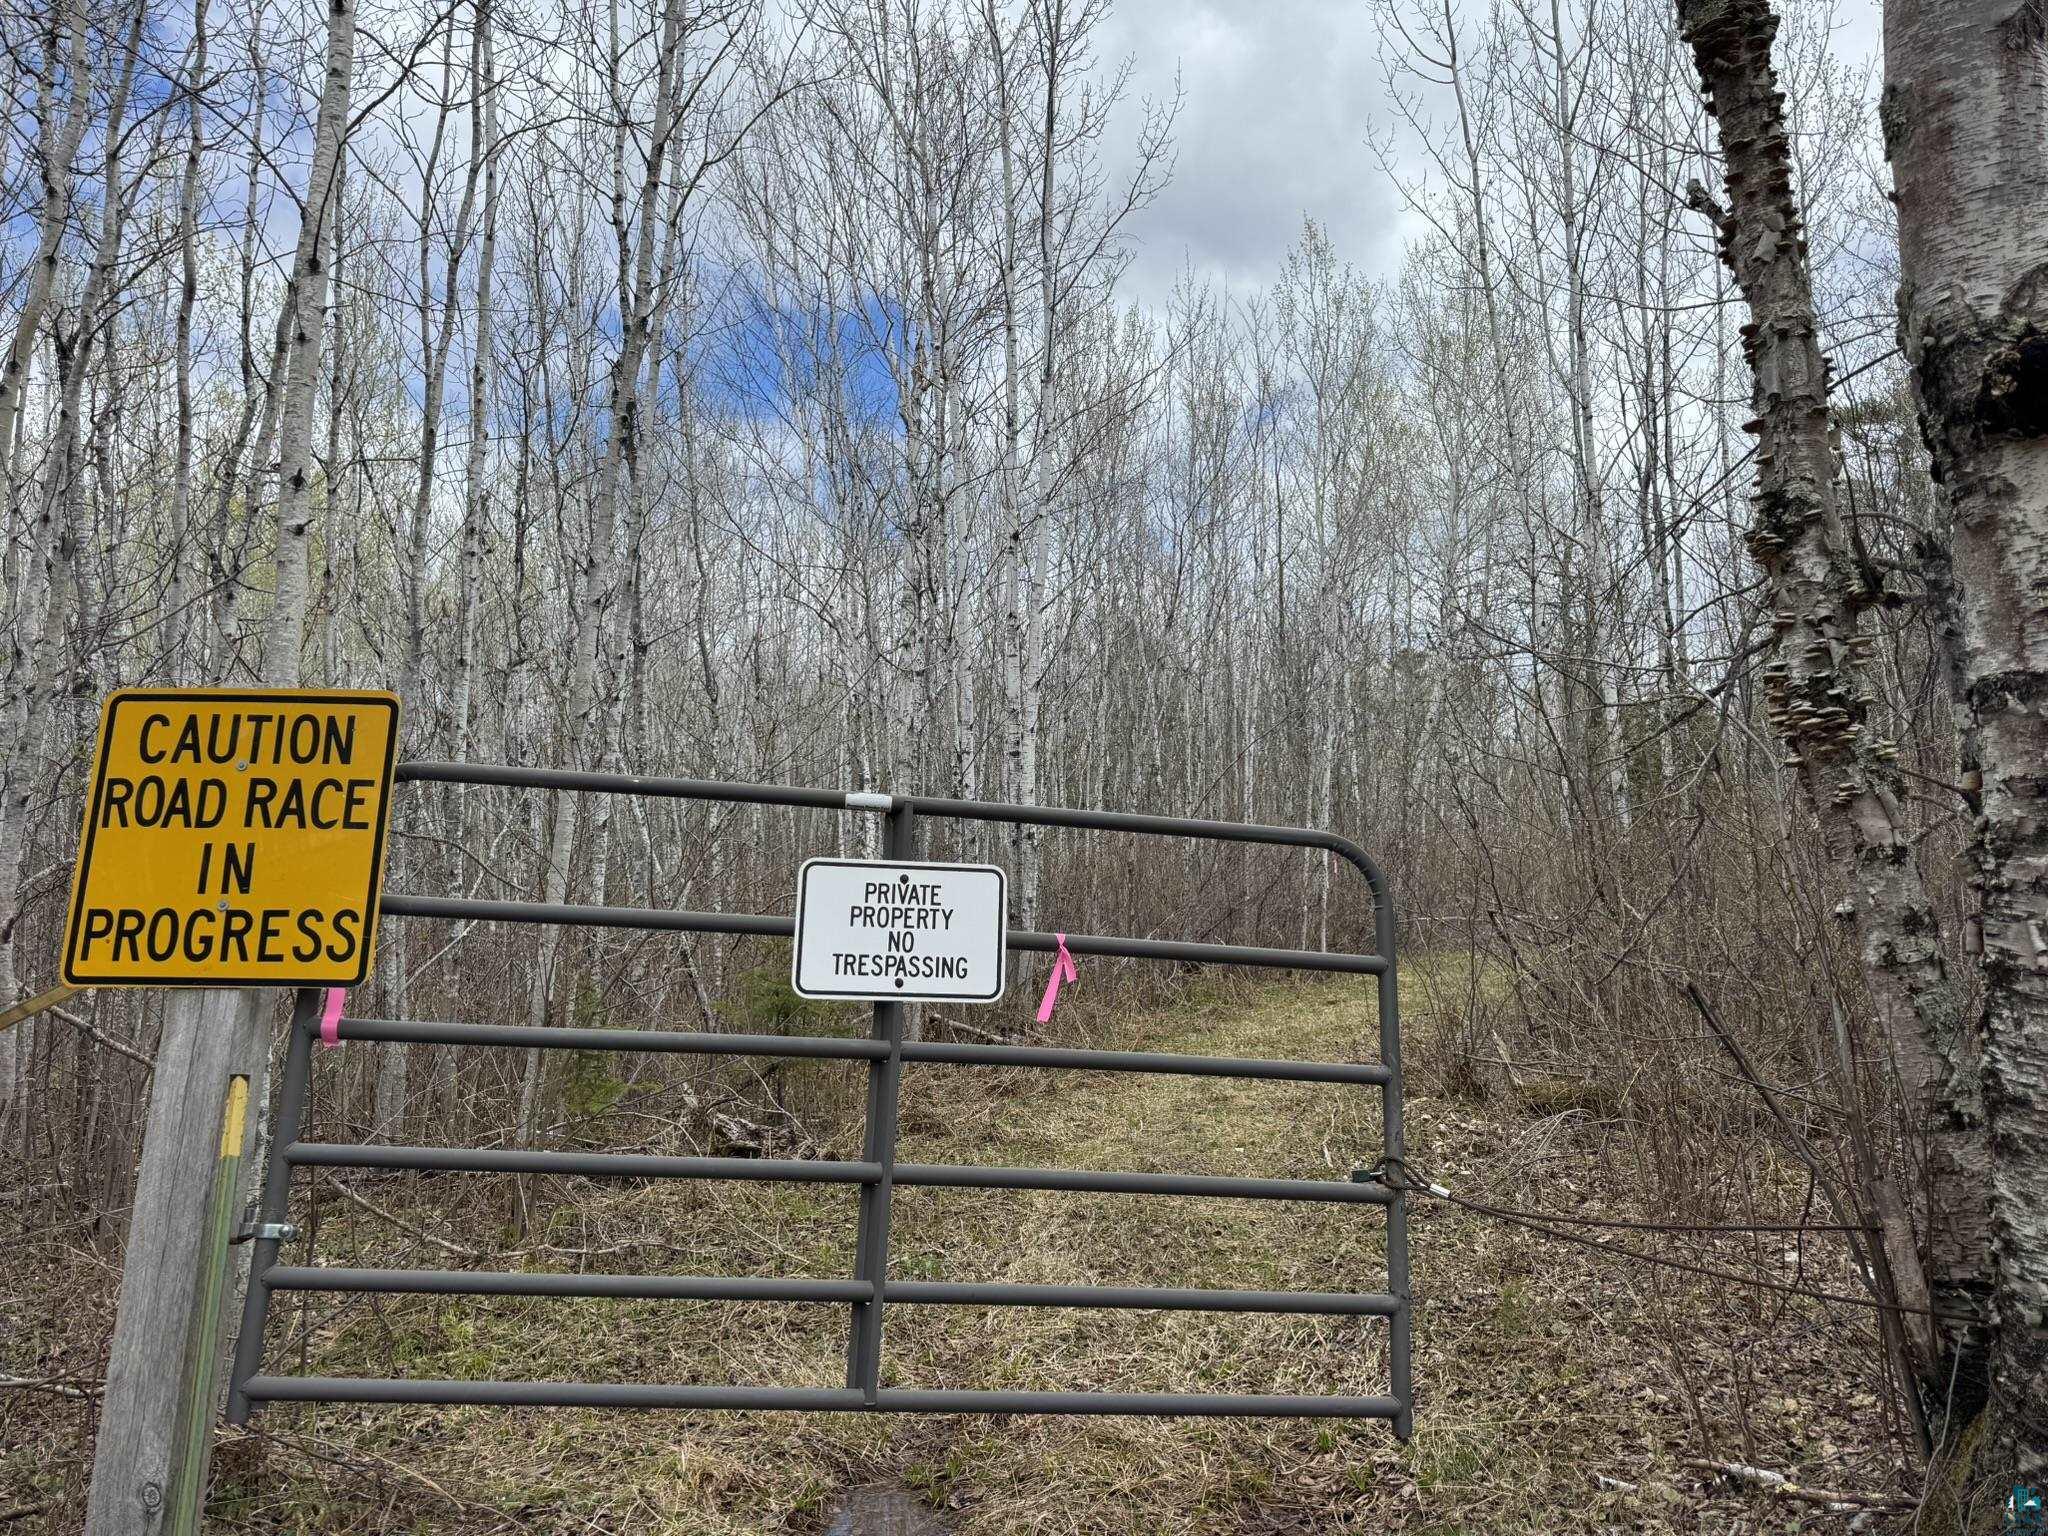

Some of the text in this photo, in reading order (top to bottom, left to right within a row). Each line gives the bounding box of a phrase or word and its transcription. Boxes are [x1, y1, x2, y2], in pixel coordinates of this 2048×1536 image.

[139, 714, 355, 764] CAUTION
[101, 776, 375, 829] ROAD RACE
[197, 843, 255, 894] IN
[865, 882, 942, 906] PRIVATE
[80, 907, 360, 963] PROGRESS
[850, 906, 954, 929] PROPERTY
[887, 931, 914, 953] NO
[833, 954, 968, 979] TRESPASSING
